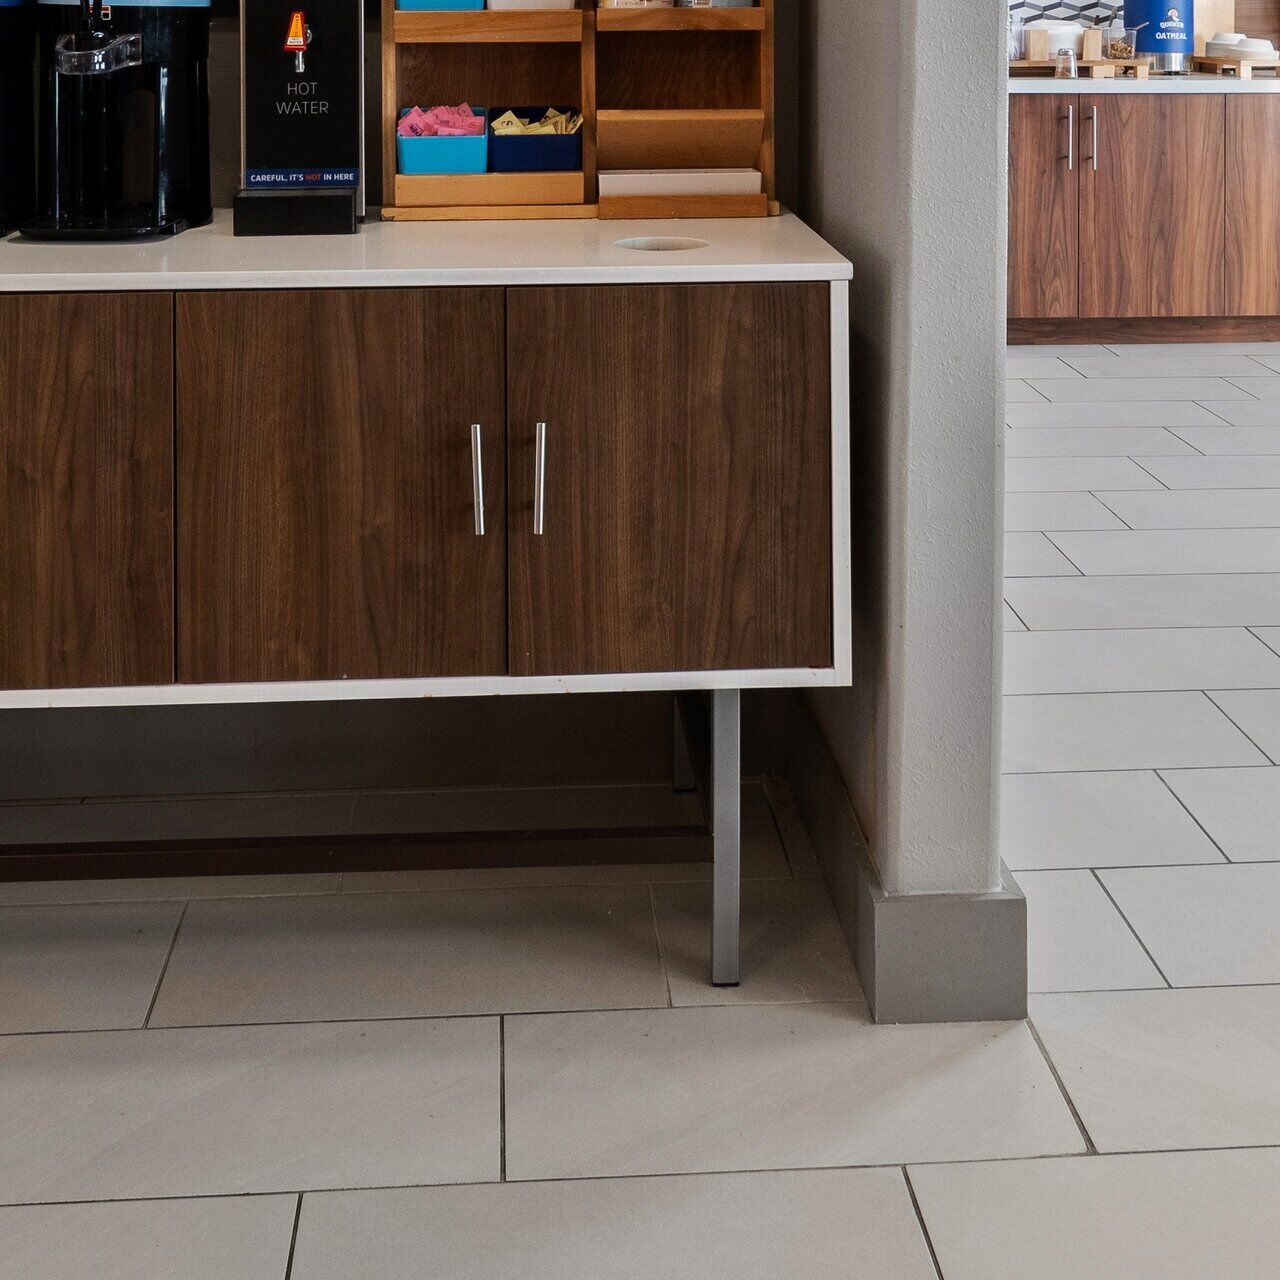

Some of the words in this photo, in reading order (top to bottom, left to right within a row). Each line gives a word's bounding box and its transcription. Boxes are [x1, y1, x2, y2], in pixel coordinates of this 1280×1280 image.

[1160, 21, 1184, 29] QUAKER
[1155, 32, 1188, 40] OATMEAL
[287, 81, 318, 96] HOT
[276, 101, 329, 115] WATER
